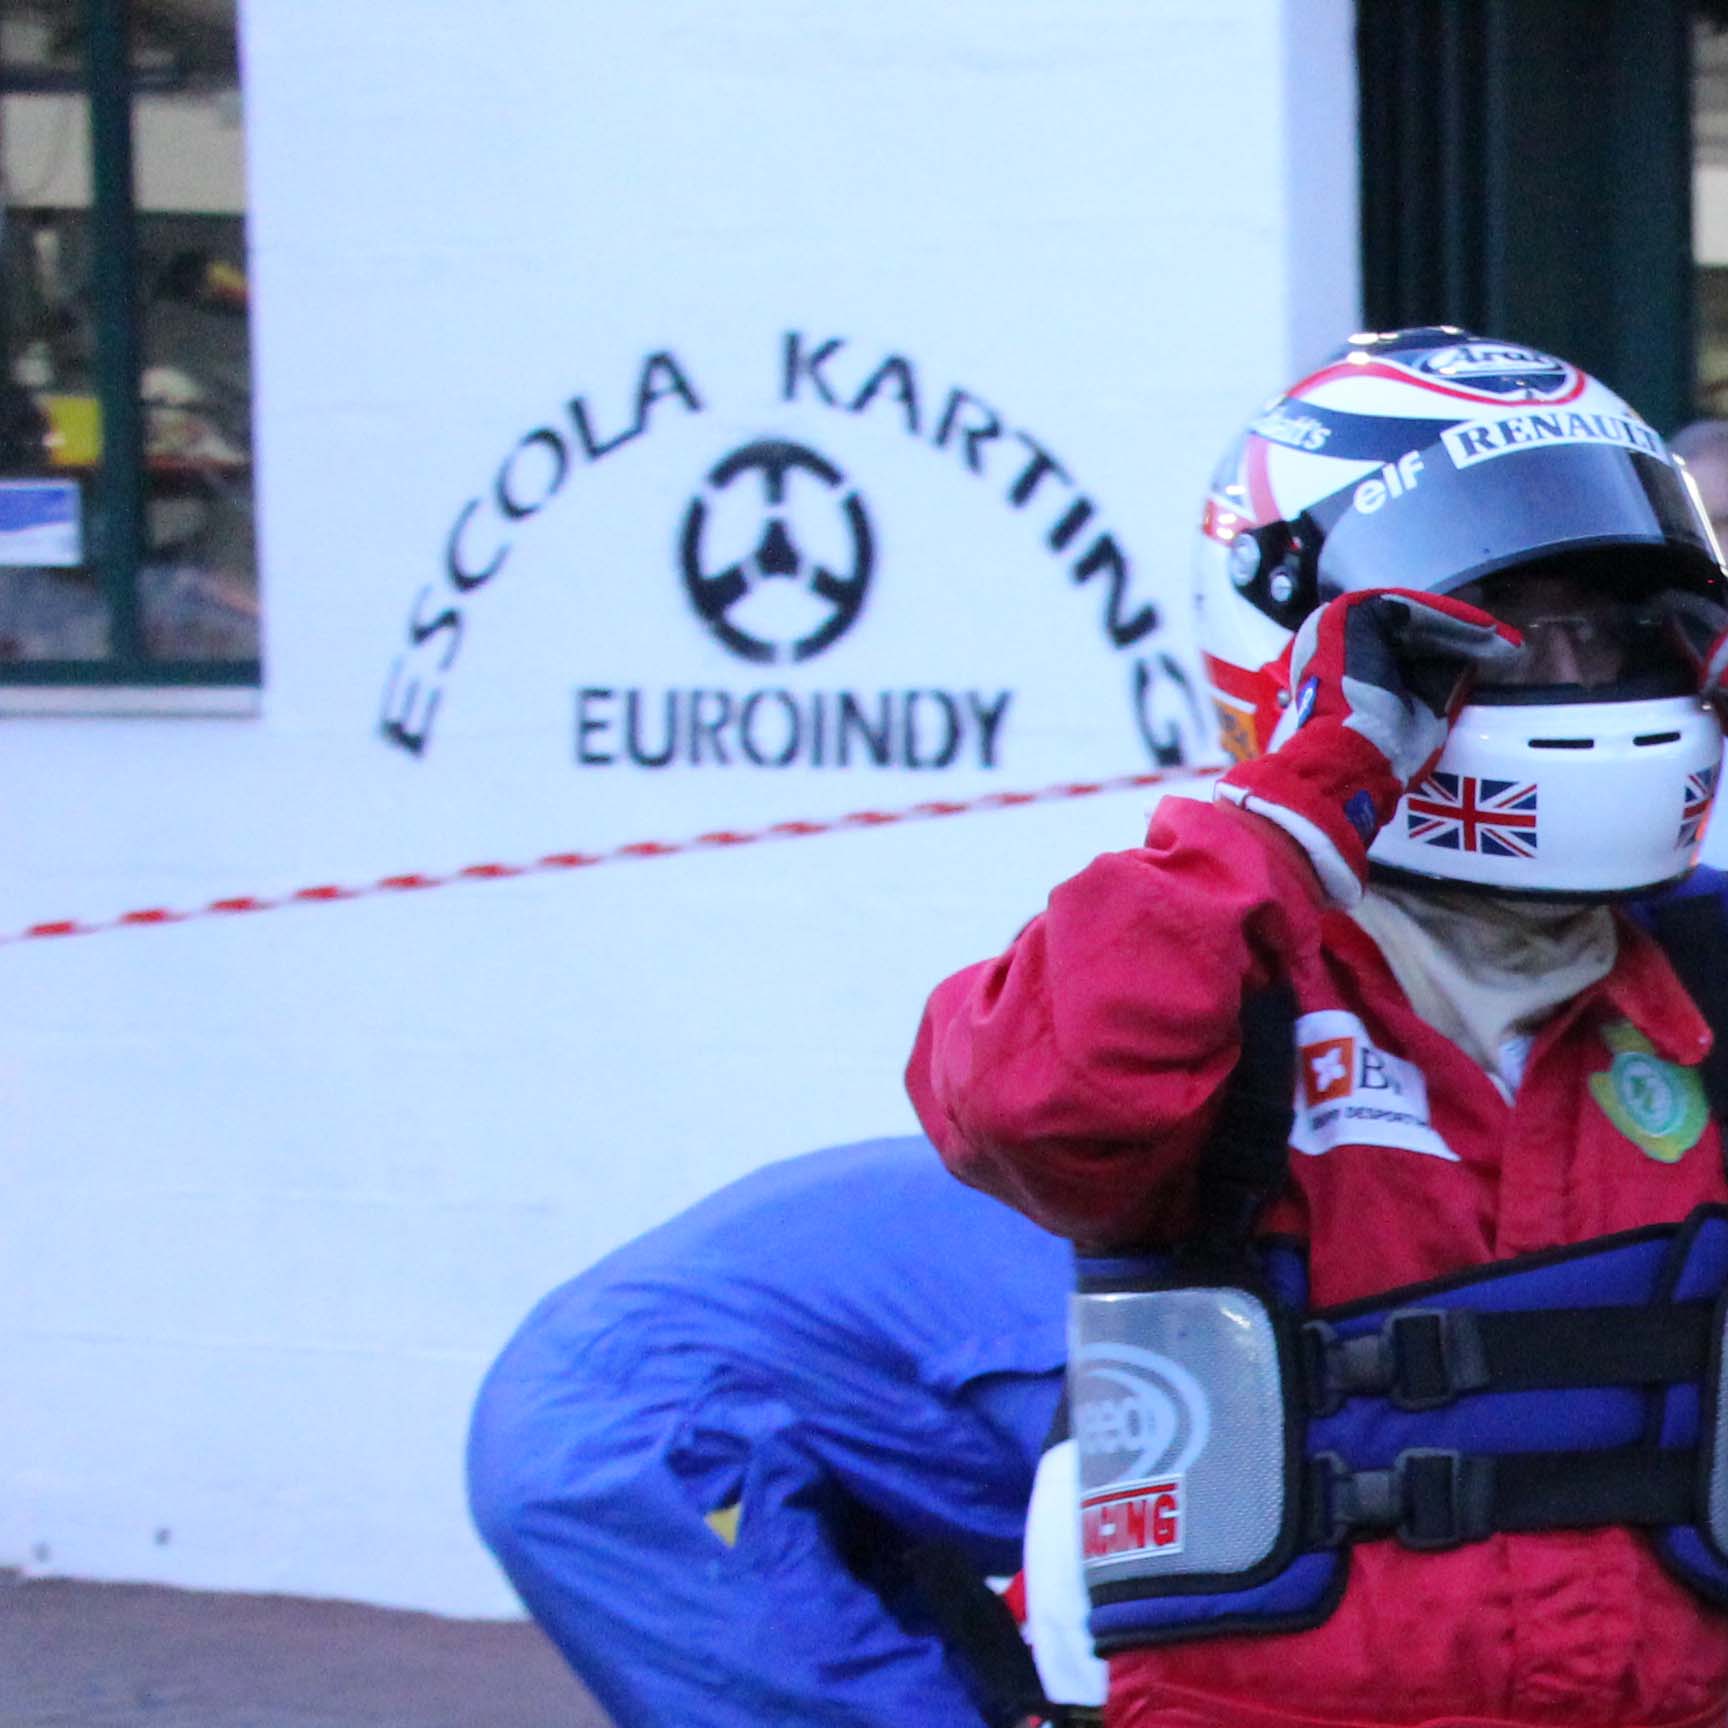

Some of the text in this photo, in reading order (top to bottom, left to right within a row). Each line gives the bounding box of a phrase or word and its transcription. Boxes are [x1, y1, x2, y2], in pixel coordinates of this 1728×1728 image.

[1457, 412, 1661, 457] RENAULT
[1353, 450, 1424, 515] elf
[378, 329, 1208, 768] ESCOLA KARTING
[574, 687, 1013, 769] EUROINDY
